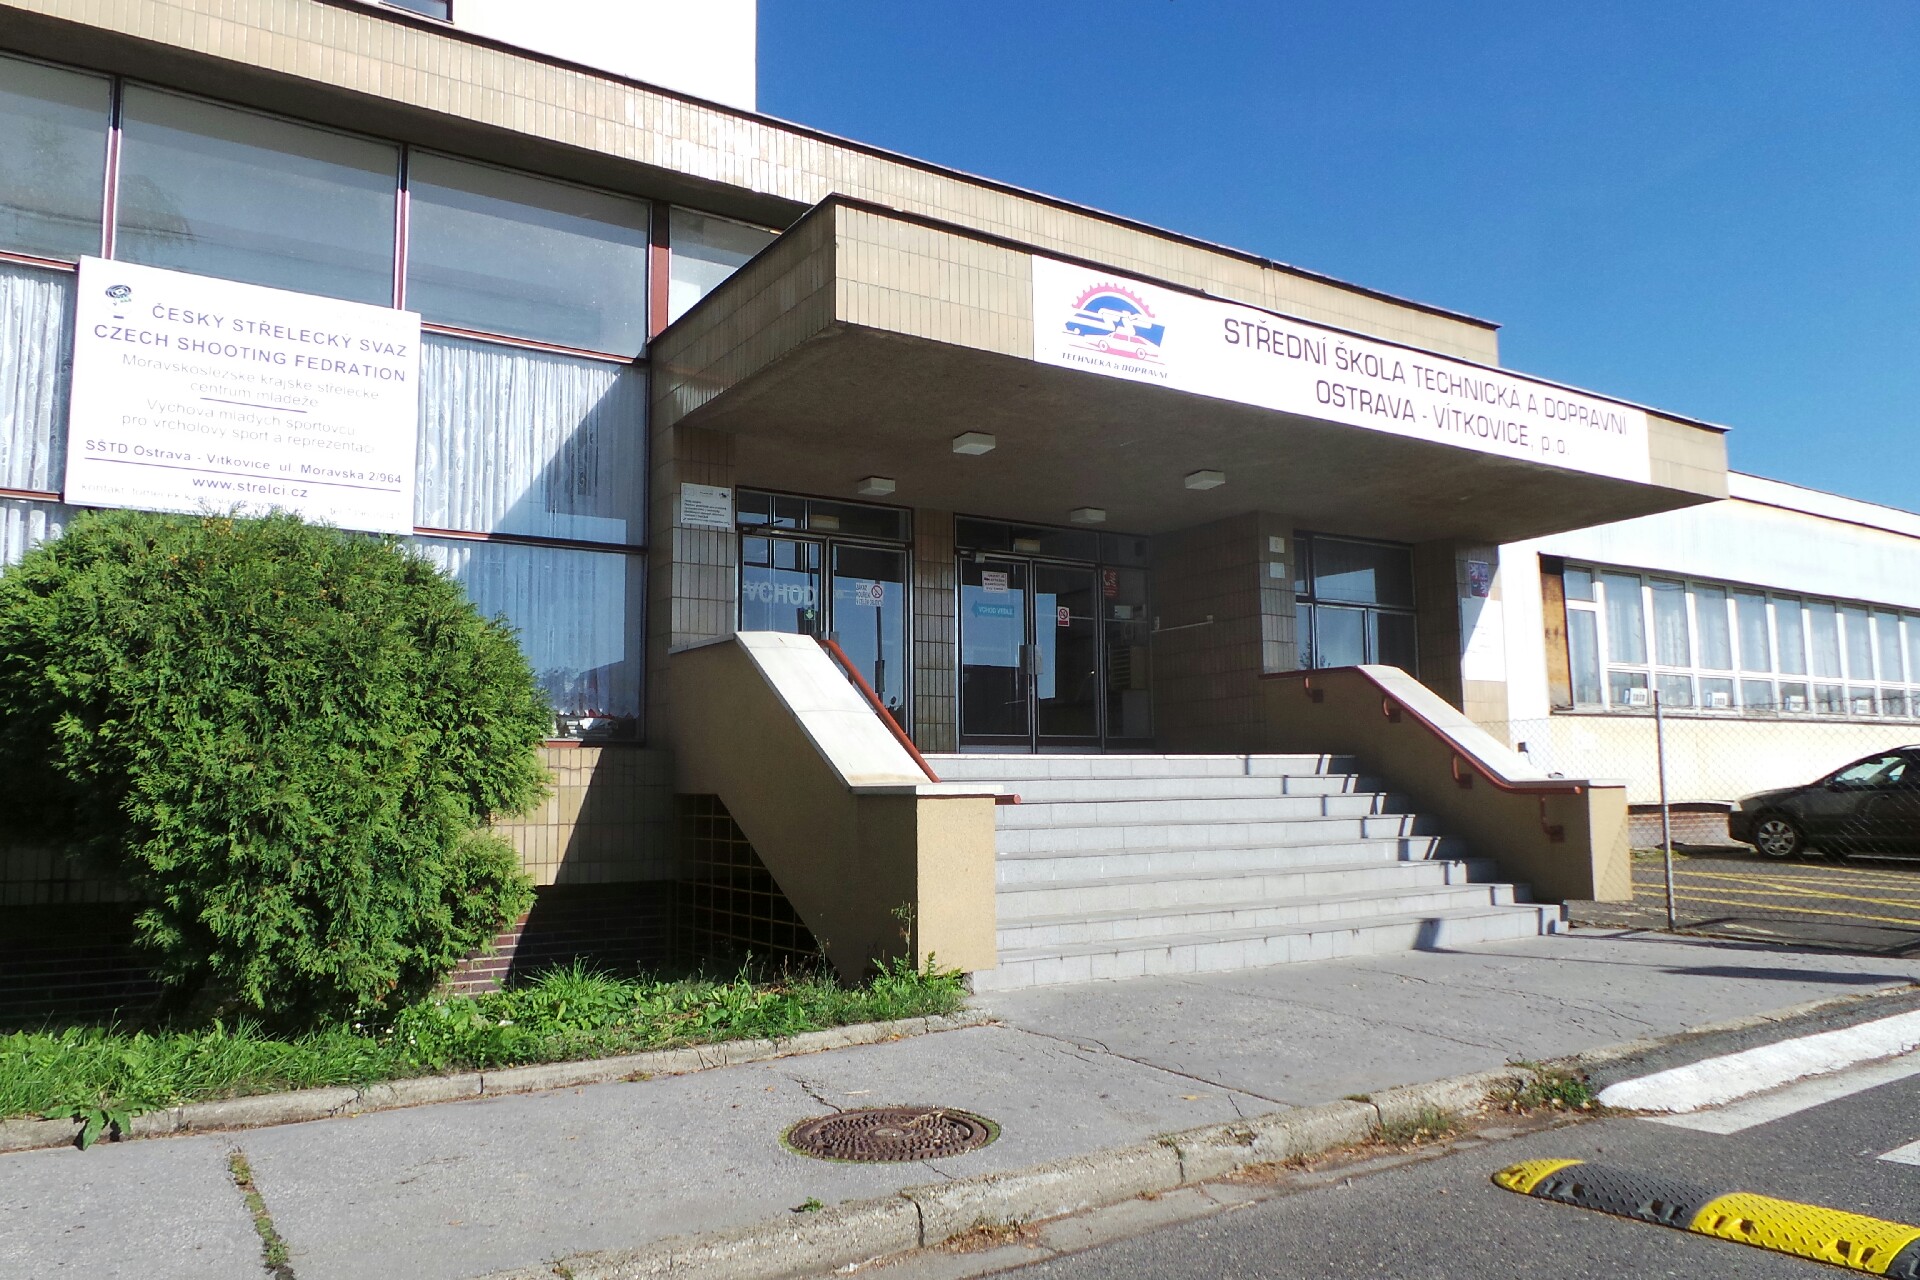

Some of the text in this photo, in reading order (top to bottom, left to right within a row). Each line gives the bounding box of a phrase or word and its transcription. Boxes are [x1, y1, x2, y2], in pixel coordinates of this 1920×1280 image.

[94, 324, 405, 382] CZECH SHOOTING FEDRATION
[232, 318, 351, 348] STŘELECKÝ
[359, 338, 407, 358] SVAZ
[190, 382, 251, 399] centrum
[1224, 318, 1627, 436] STŘEDNÍ ŠKOLA TECHNICKÁ A DOPRAVNÍ
[1316, 380, 1416, 423] OSTRAVA
[122, 415, 147, 427] pro
[232, 429, 268, 442] sport
[133, 445, 191, 461] Ostrava
[192, 477, 308, 498] www.strelci.cz
